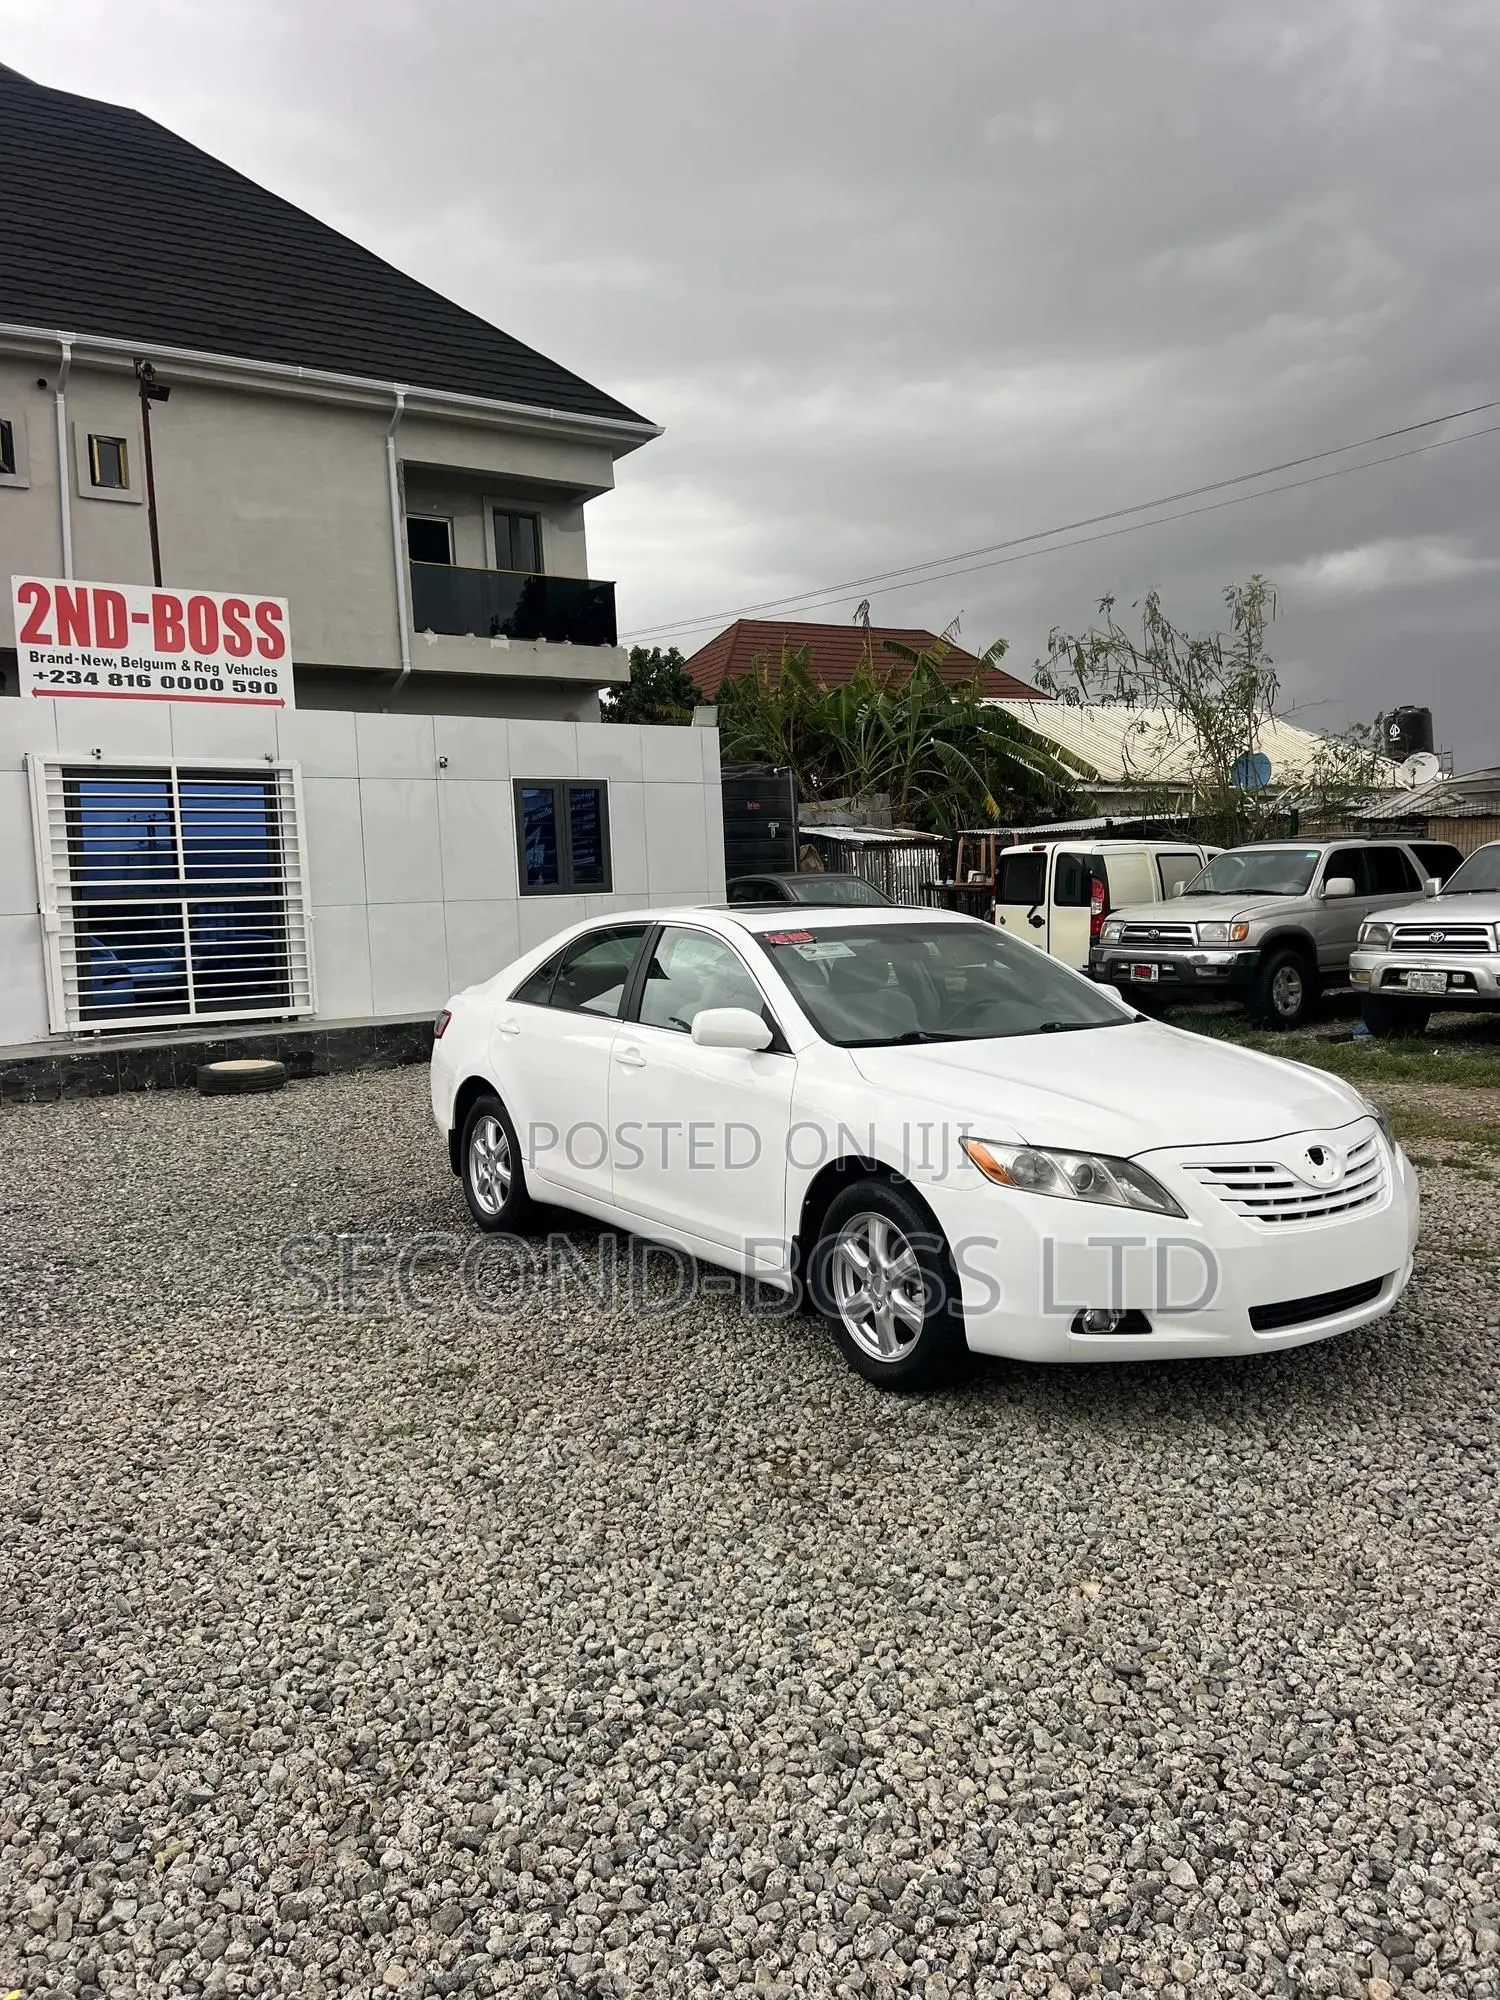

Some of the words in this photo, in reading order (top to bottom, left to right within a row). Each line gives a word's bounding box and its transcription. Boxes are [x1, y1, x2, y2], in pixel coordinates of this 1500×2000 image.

[17, 582, 286, 660] 2ND-BOSS
[29, 650, 117, 669] Brand-New,
[181, 659, 191, 671] &
[194, 660, 220, 676] Reg
[225, 663, 278, 678] Vehicles
[33, 669, 99, 685] +234
[108, 673, 151, 688] 816
[160, 675, 225, 692] 0000
[232, 679, 278, 695] 590
